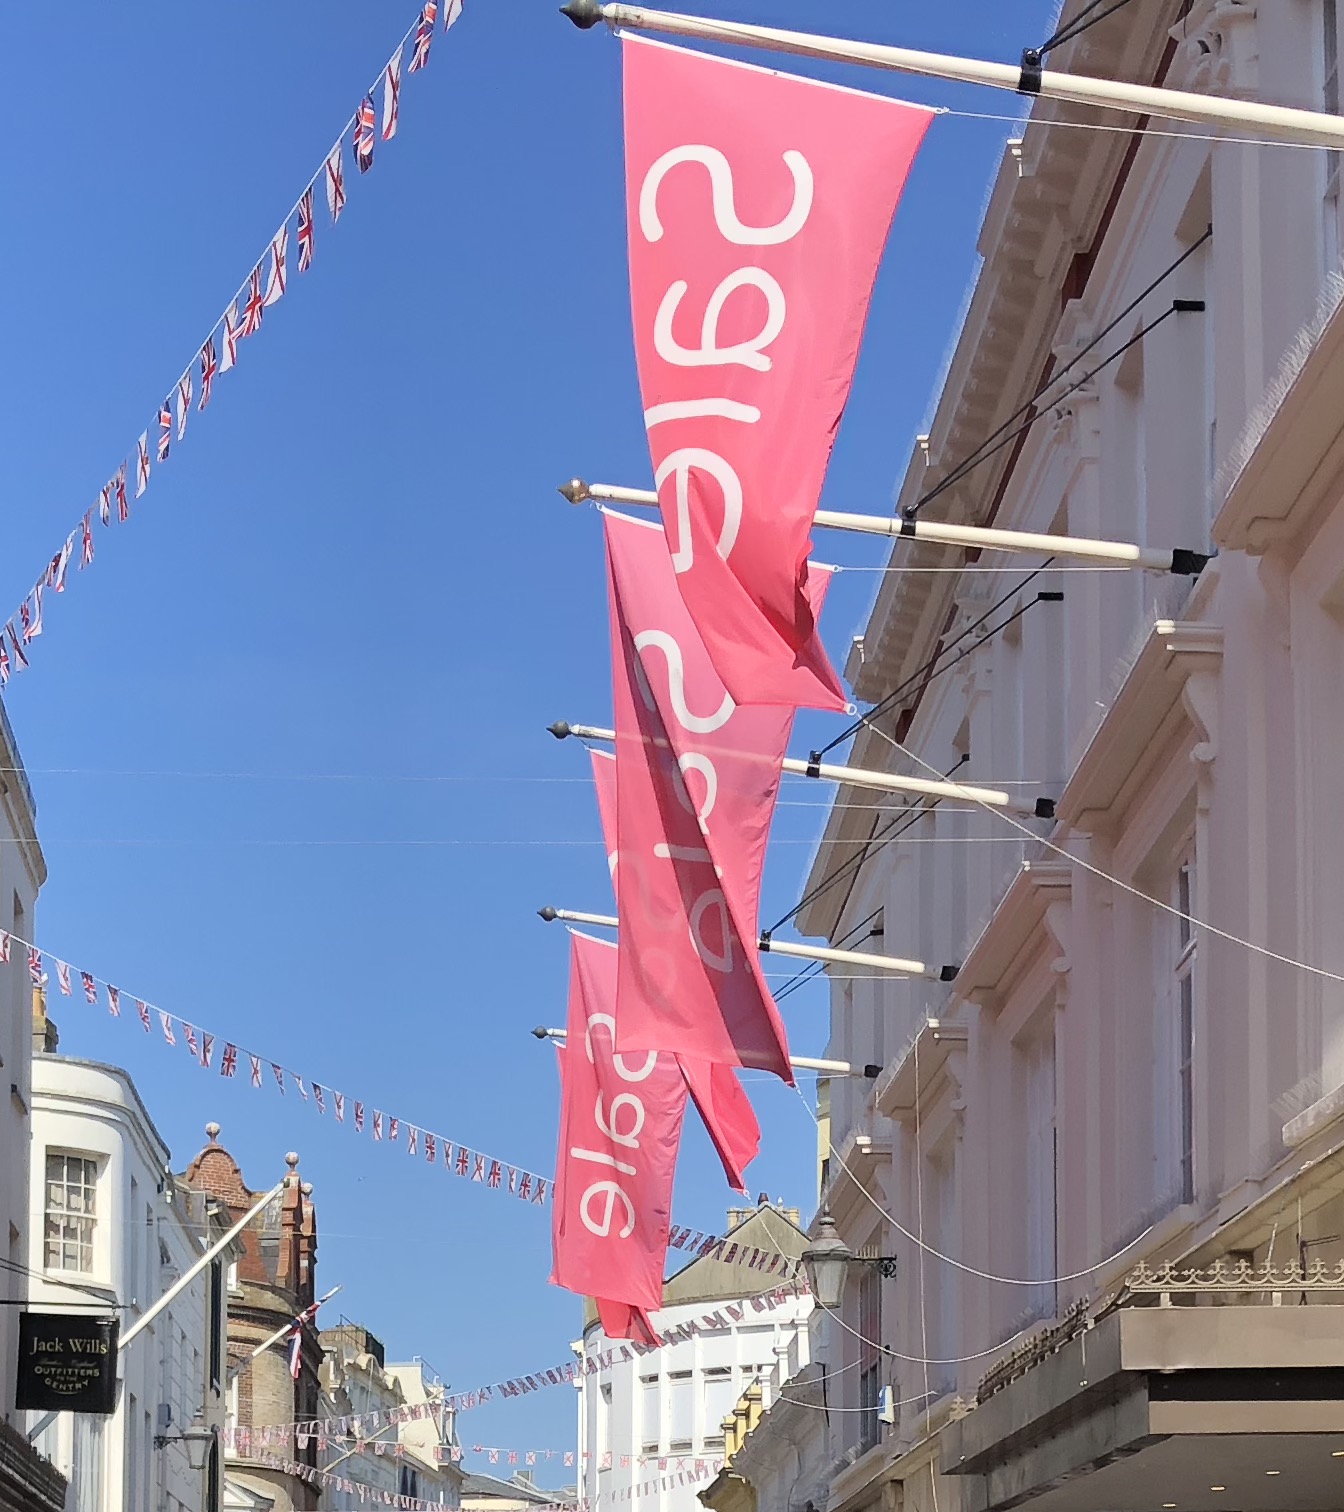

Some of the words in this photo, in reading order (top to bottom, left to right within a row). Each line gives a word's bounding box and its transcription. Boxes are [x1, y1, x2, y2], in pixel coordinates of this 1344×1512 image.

[29, 1336, 64, 1356] Jack
[68, 1338, 109, 1355] Wills
[34, 1365, 100, 1378] OUTFITTERS
[45, 1377, 89, 1391] GENTRY
